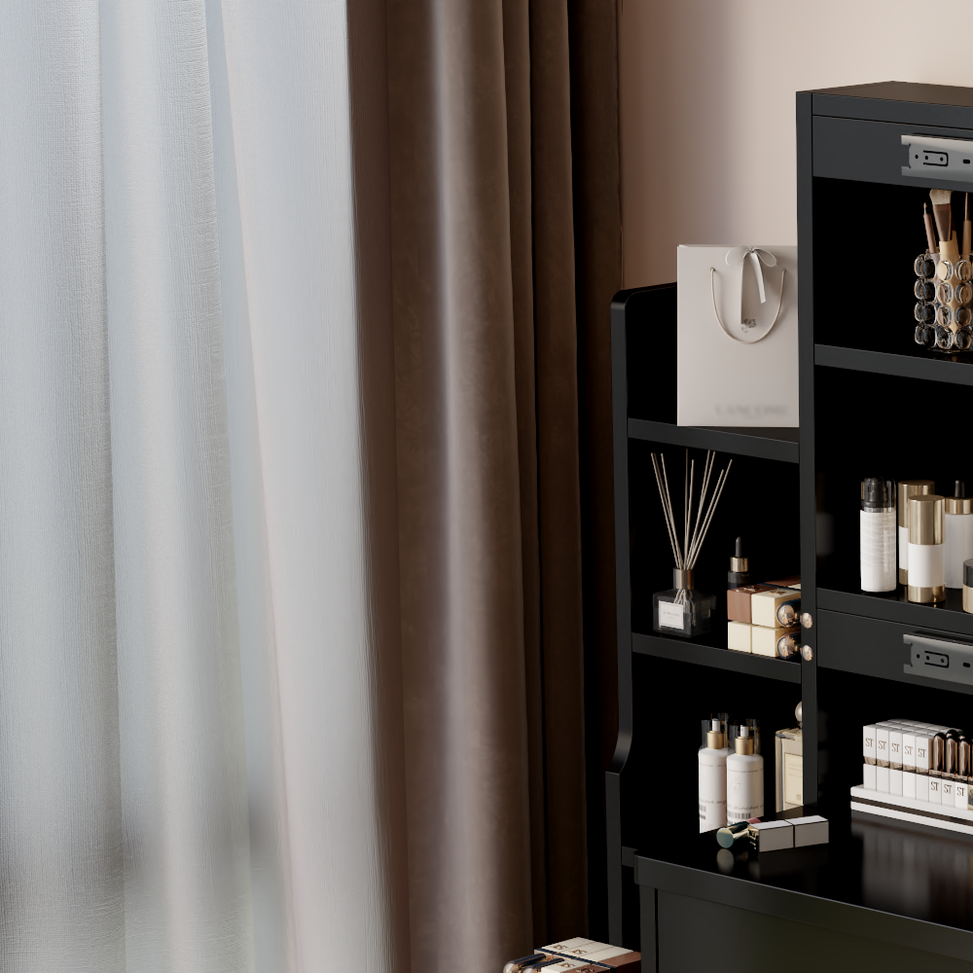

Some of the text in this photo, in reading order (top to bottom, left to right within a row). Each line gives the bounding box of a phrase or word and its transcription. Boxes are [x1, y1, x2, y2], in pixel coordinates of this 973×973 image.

[866, 738, 874, 748] ST
[878, 740, 887, 750] ST
[891, 743, 900, 753] ST
[904, 745, 913, 755] ST
[918, 748, 927, 758] ST
[931, 781, 940, 791] ST
[944, 784, 952, 794] ST
[957, 787, 965, 796] ST
